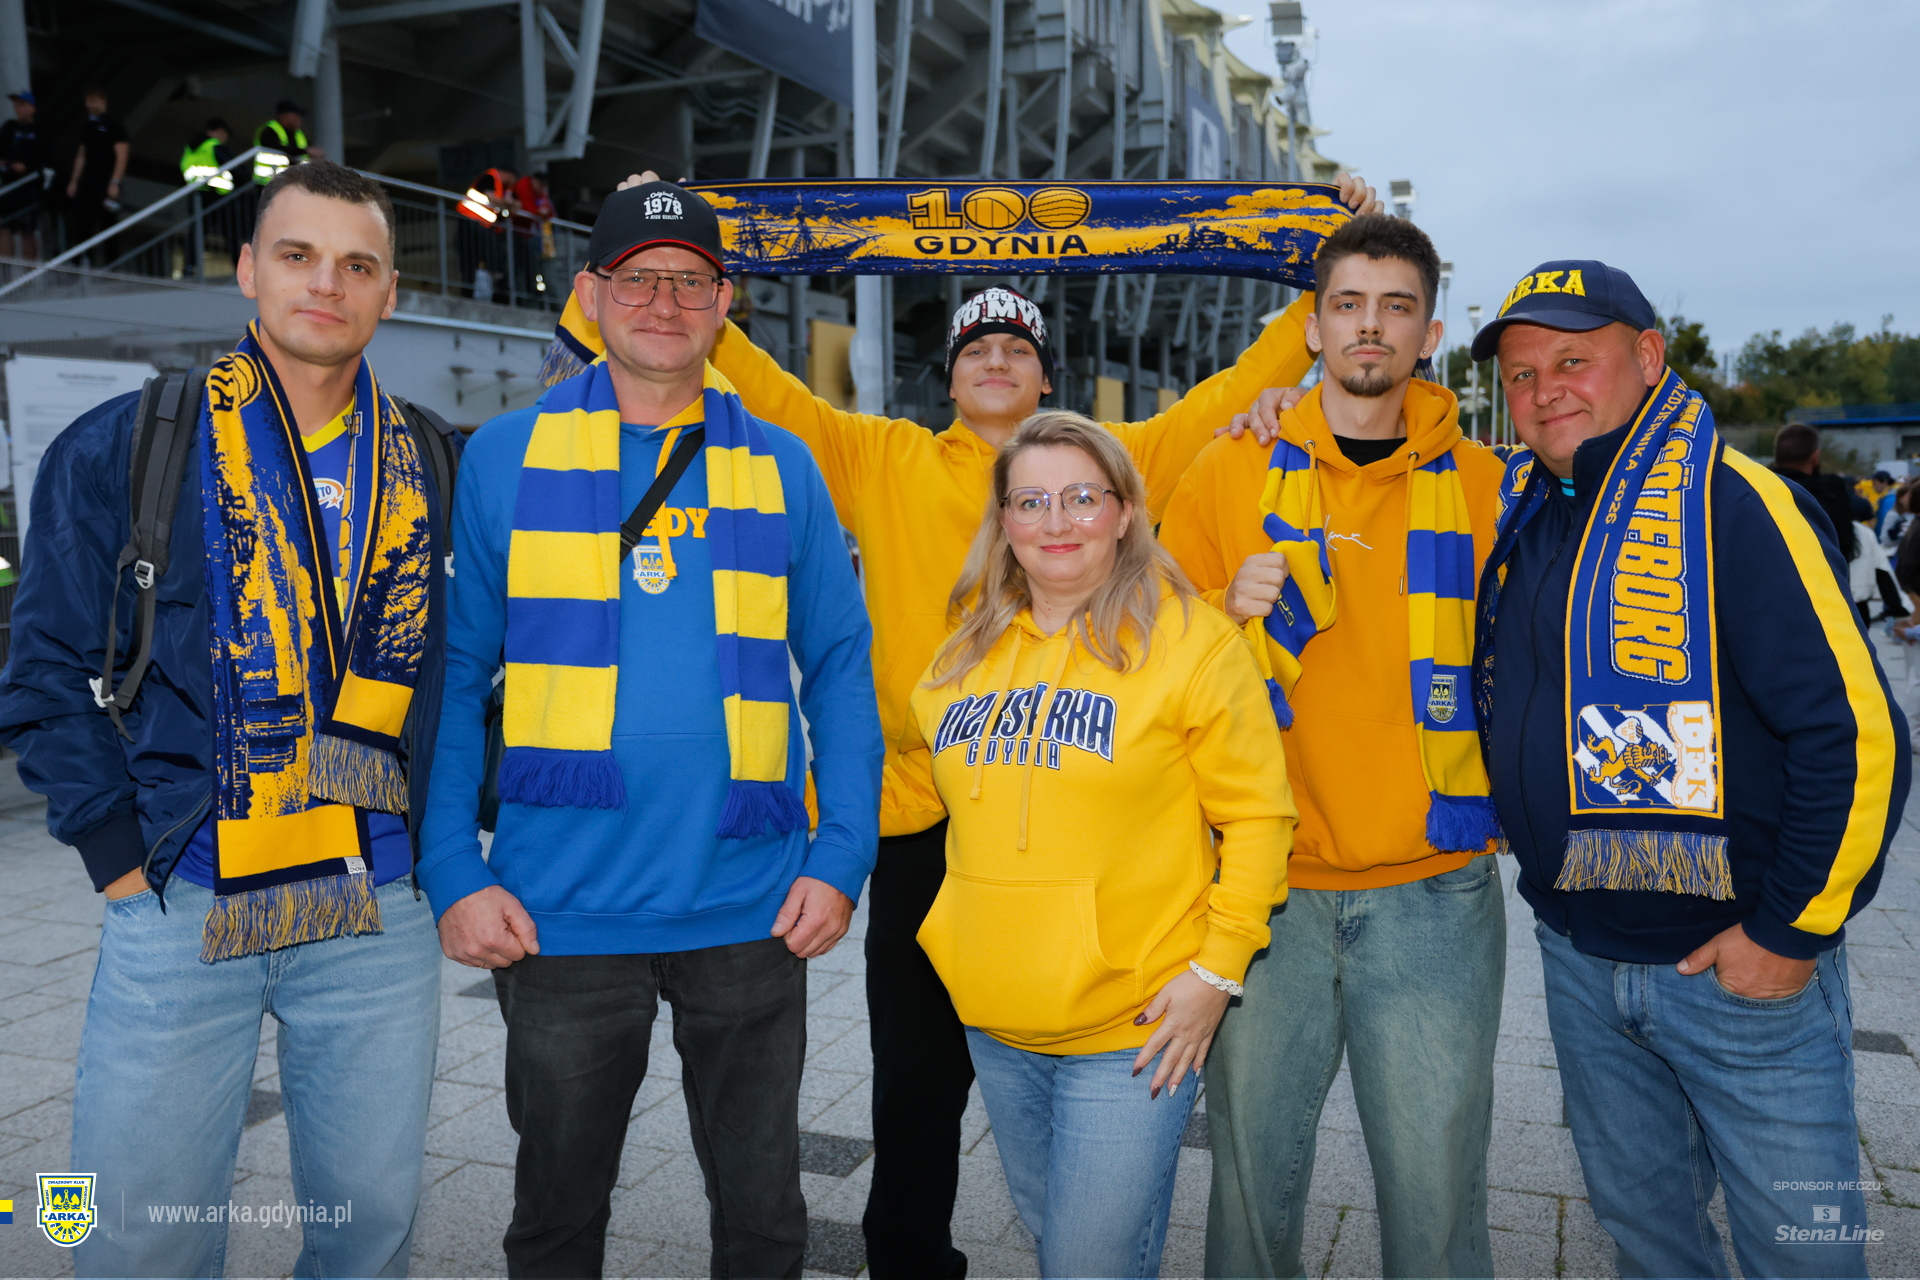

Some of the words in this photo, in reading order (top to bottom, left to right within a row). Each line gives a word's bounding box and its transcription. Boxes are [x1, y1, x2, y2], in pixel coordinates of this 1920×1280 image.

[643, 197, 683, 216] 1978
[907, 187, 1091, 231] 100
[914, 235, 1088, 255] GDYNIA
[1605, 478, 1630, 524] 2026
[1610, 437, 1693, 685] GÖTEBORG
[965, 738, 1060, 770] GDYNIA
